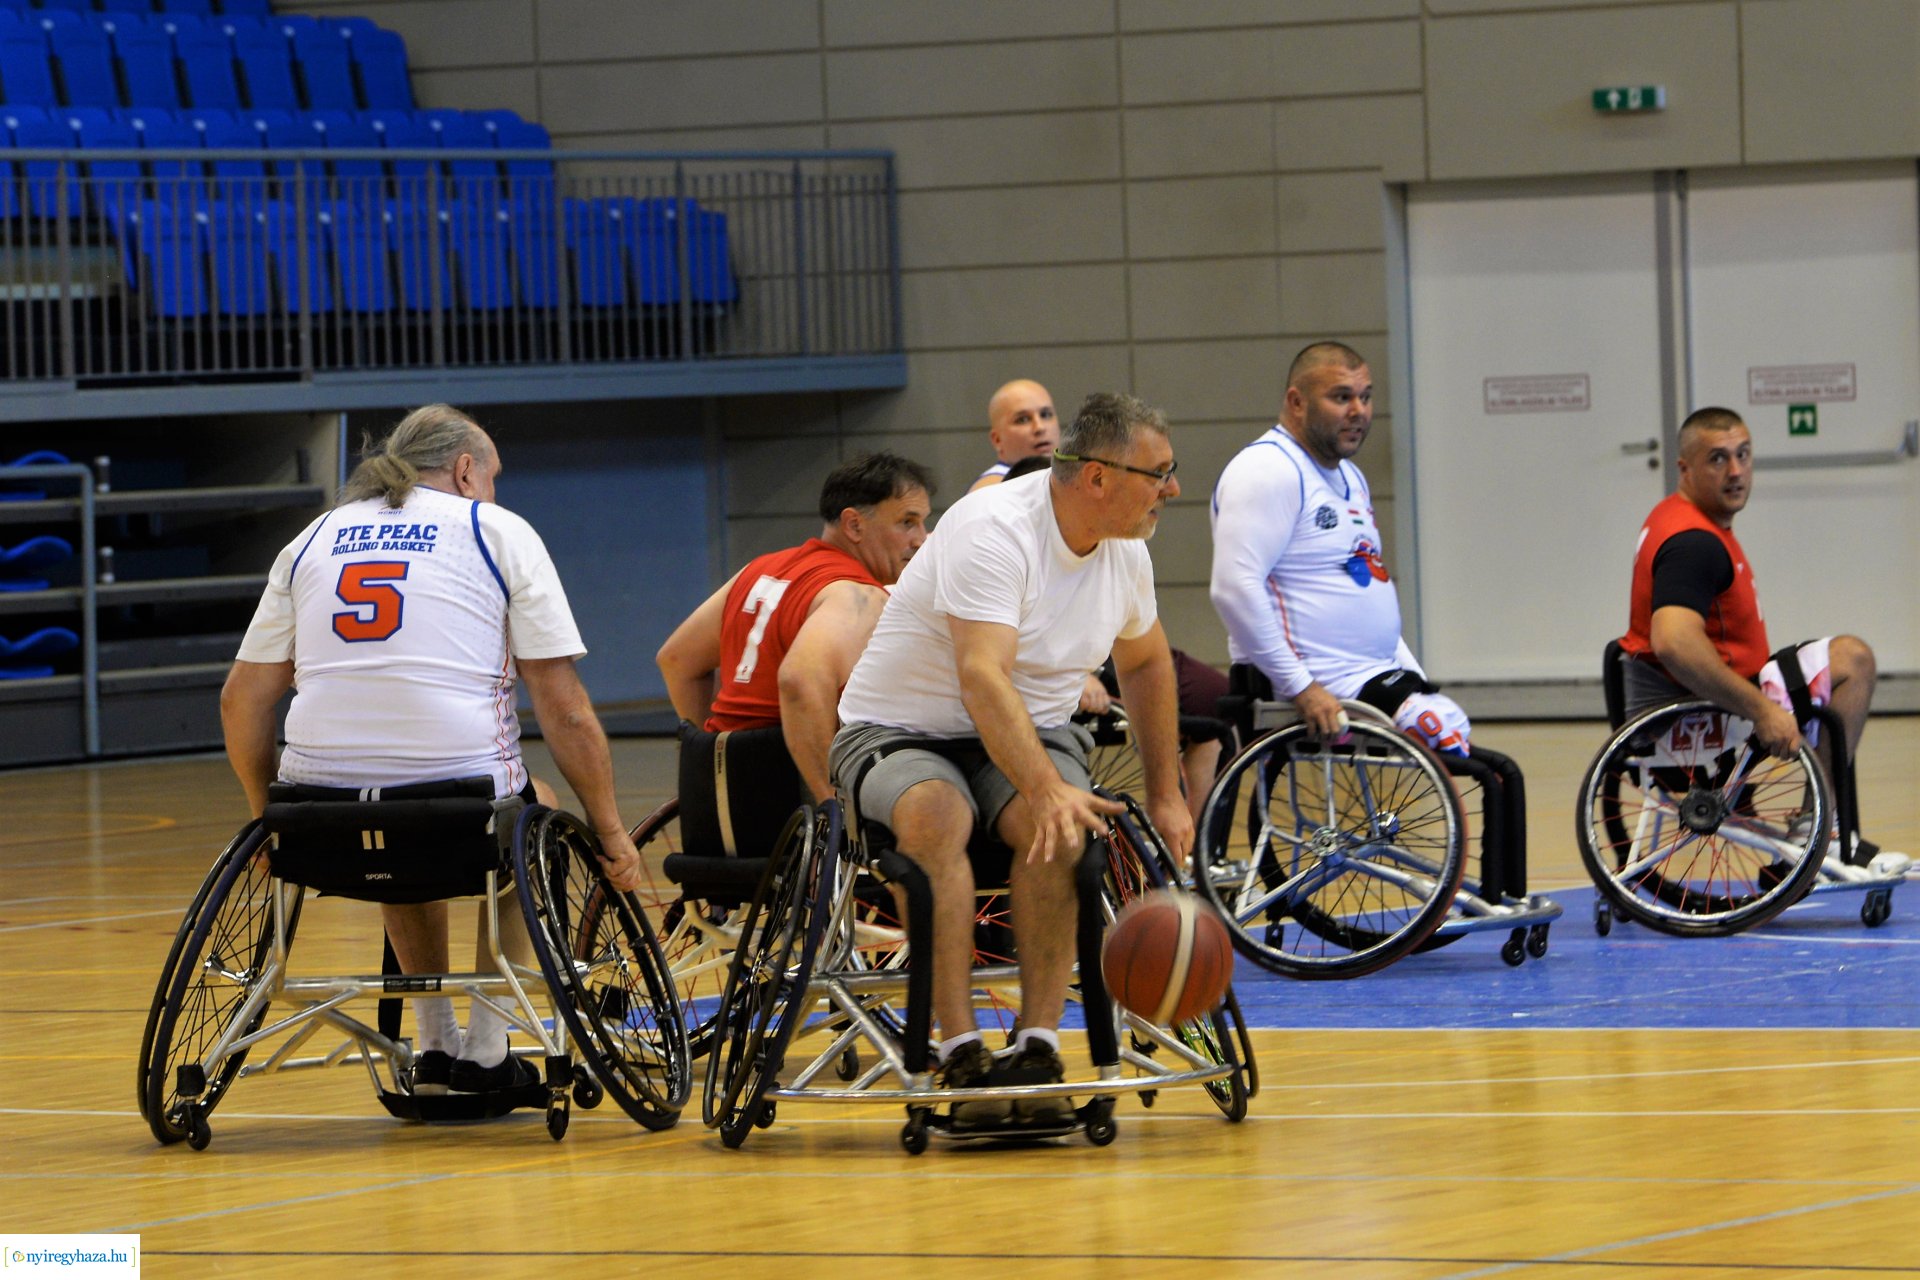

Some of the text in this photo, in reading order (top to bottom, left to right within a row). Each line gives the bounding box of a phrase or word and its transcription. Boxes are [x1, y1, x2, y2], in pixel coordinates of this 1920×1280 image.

[331, 541, 436, 556] ROLLING BASKET
[334, 524, 439, 545] PTE PEAC
[332, 560, 410, 643] 5
[733, 574, 792, 684] 7
